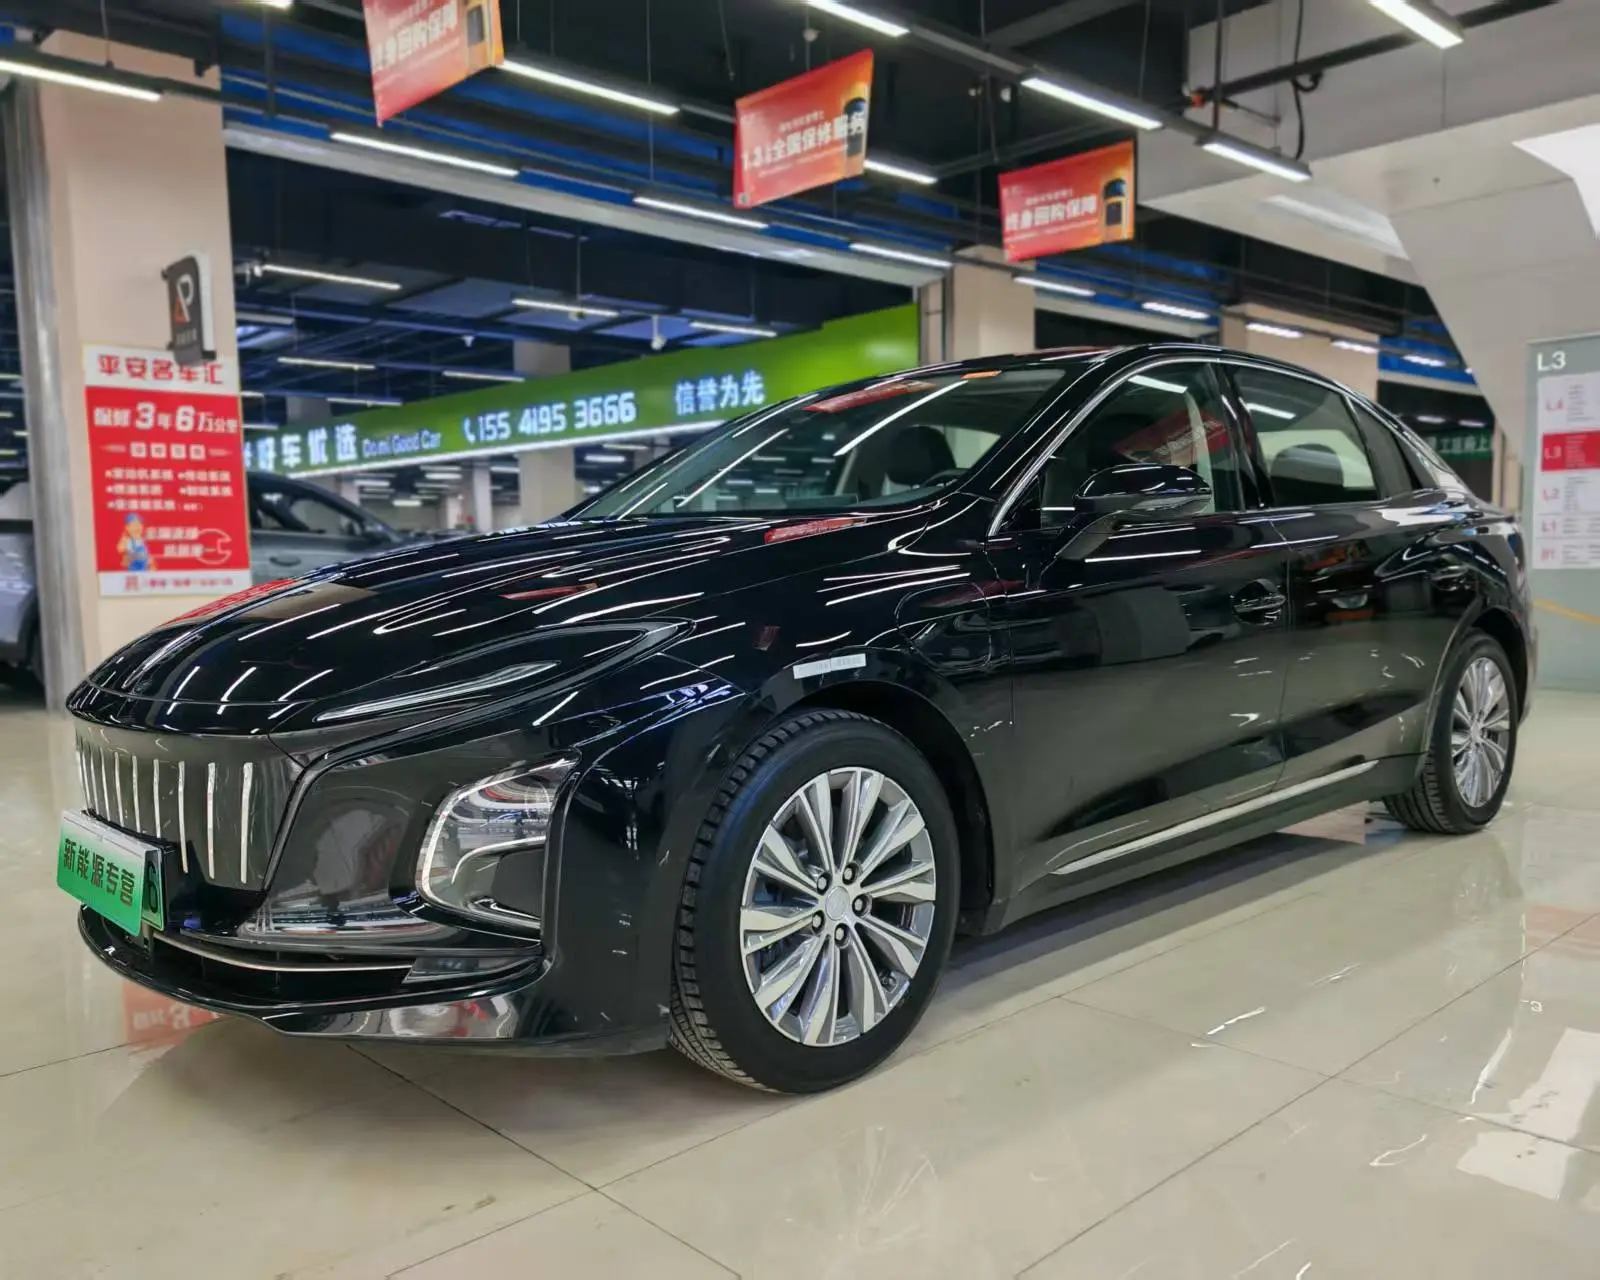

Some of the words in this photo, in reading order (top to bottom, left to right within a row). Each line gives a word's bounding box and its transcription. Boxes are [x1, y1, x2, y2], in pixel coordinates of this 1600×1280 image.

[98, 354, 224, 385] 平安名车汇
[1538, 350, 1566, 371] L3
[675, 370, 766, 415] 信誉为先
[478, 413, 511, 441] 155
[518, 403, 567, 434] 4195
[574, 392, 637, 429] 3666
[420, 428, 441, 449] Car
[63, 838, 136, 907] 新能源专营
